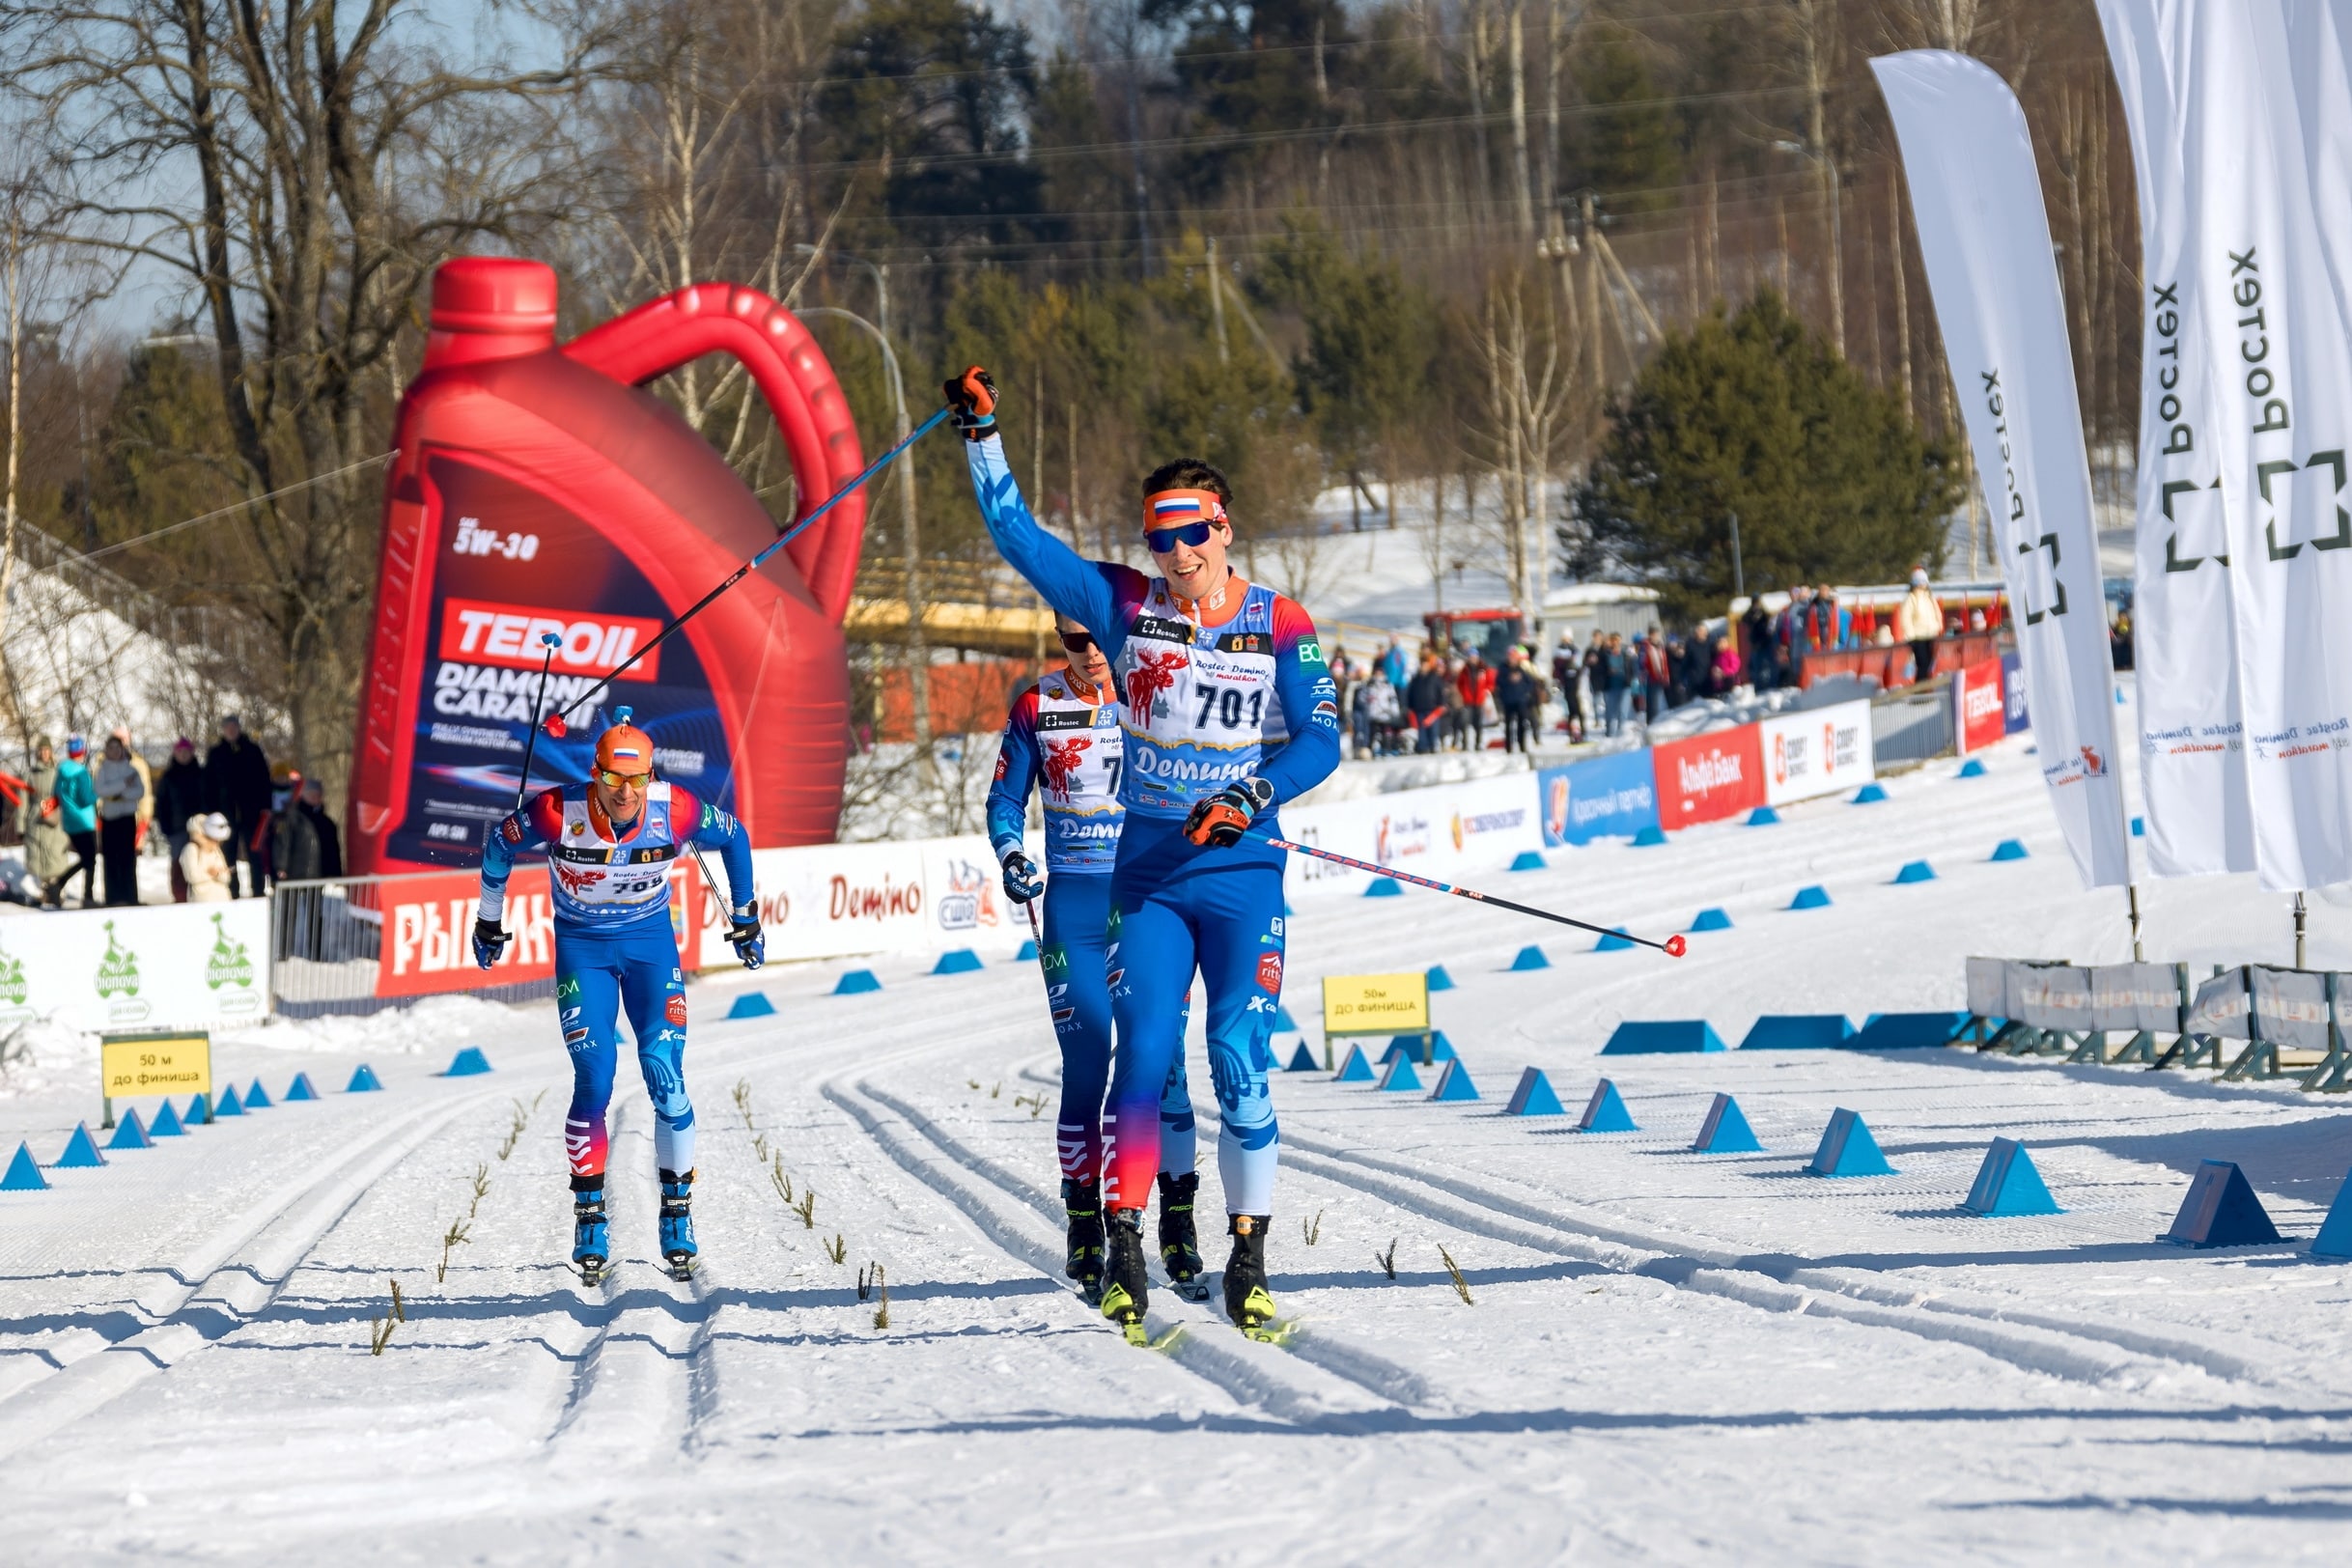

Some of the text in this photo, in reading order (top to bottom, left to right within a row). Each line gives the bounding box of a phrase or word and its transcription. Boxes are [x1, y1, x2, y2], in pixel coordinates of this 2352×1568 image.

[453, 527, 540, 561] 5W-30
[458, 609, 643, 671] TEBOIL
[1156, 629, 1180, 638] Rostec
[1195, 659, 1267, 676] Rostec Demino
[434, 661, 609, 706] DIAMOND
[1216, 673, 1257, 683] marathon
[434, 686, 556, 725] CARAT
[1194, 682, 1265, 730] 701
[1100, 709, 1113, 719] 25
[1102, 755, 1122, 797] 7
[615, 850, 627, 858] 25
[1012, 882, 1030, 896] COXA
[829, 873, 921, 922] Demino
[1364, 989, 1386, 999] 50м
[1334, 1001, 1416, 1016] ДО ФИНИША
[139, 1054, 172, 1066] 50 м
[112, 1072, 200, 1087] до финиша
